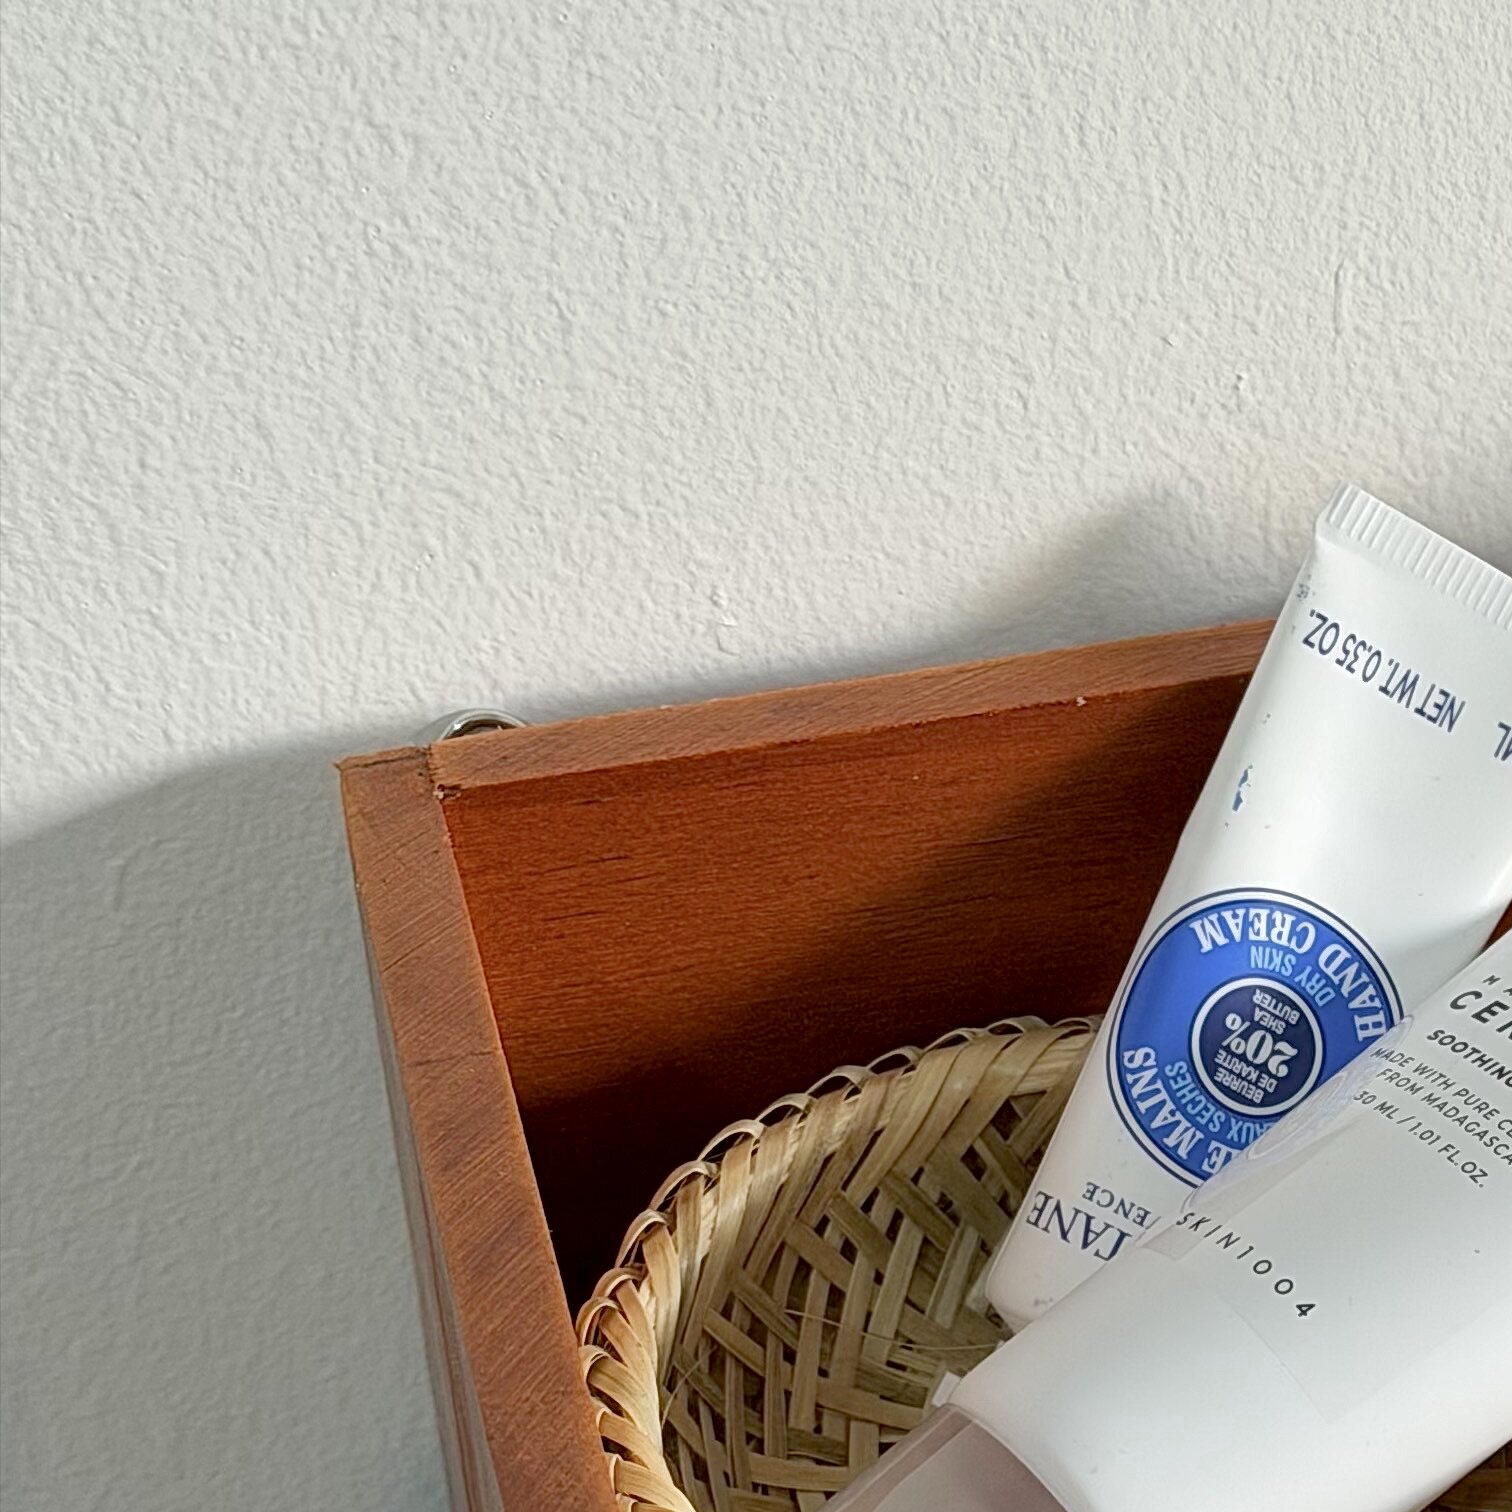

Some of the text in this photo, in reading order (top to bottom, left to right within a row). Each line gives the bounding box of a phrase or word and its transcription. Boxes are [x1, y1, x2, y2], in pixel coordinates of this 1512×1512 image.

[1302, 609, 1340, 656] OZ.
[1335, 634, 1382, 683] 0.35
[1414, 684, 1466, 733] NET
[1188, 908, 1386, 1042] HAND CREAM
[1250, 945, 1336, 1008] DRY SKIN
[1252, 988, 1301, 1025] BUTTER
[1254, 1006, 1286, 1035] SHEA
[1214, 1049, 1278, 1093] DE KARITE
[1221, 1012, 1298, 1078] 20%
[1122, 1046, 1203, 1160] MAINS
[1164, 1061, 1280, 1146] AUX SECHES
[1214, 1067, 1264, 1104] BEURRE
[1370, 1047, 1416, 1069] MADE
[1412, 1061, 1456, 1091] WITH
[1452, 1087, 1501, 1123] PURE
[1375, 1067, 1425, 1097] FROM
[1353, 1090, 1376, 1107] 30
[1373, 1094, 1401, 1120] ML
[1408, 1123, 1442, 1146] 1.01
[1025, 1190, 1133, 1261] TANE
[1082, 1181, 1161, 1229] ENCE
[1175, 1212, 1316, 1318] SKIN1004
